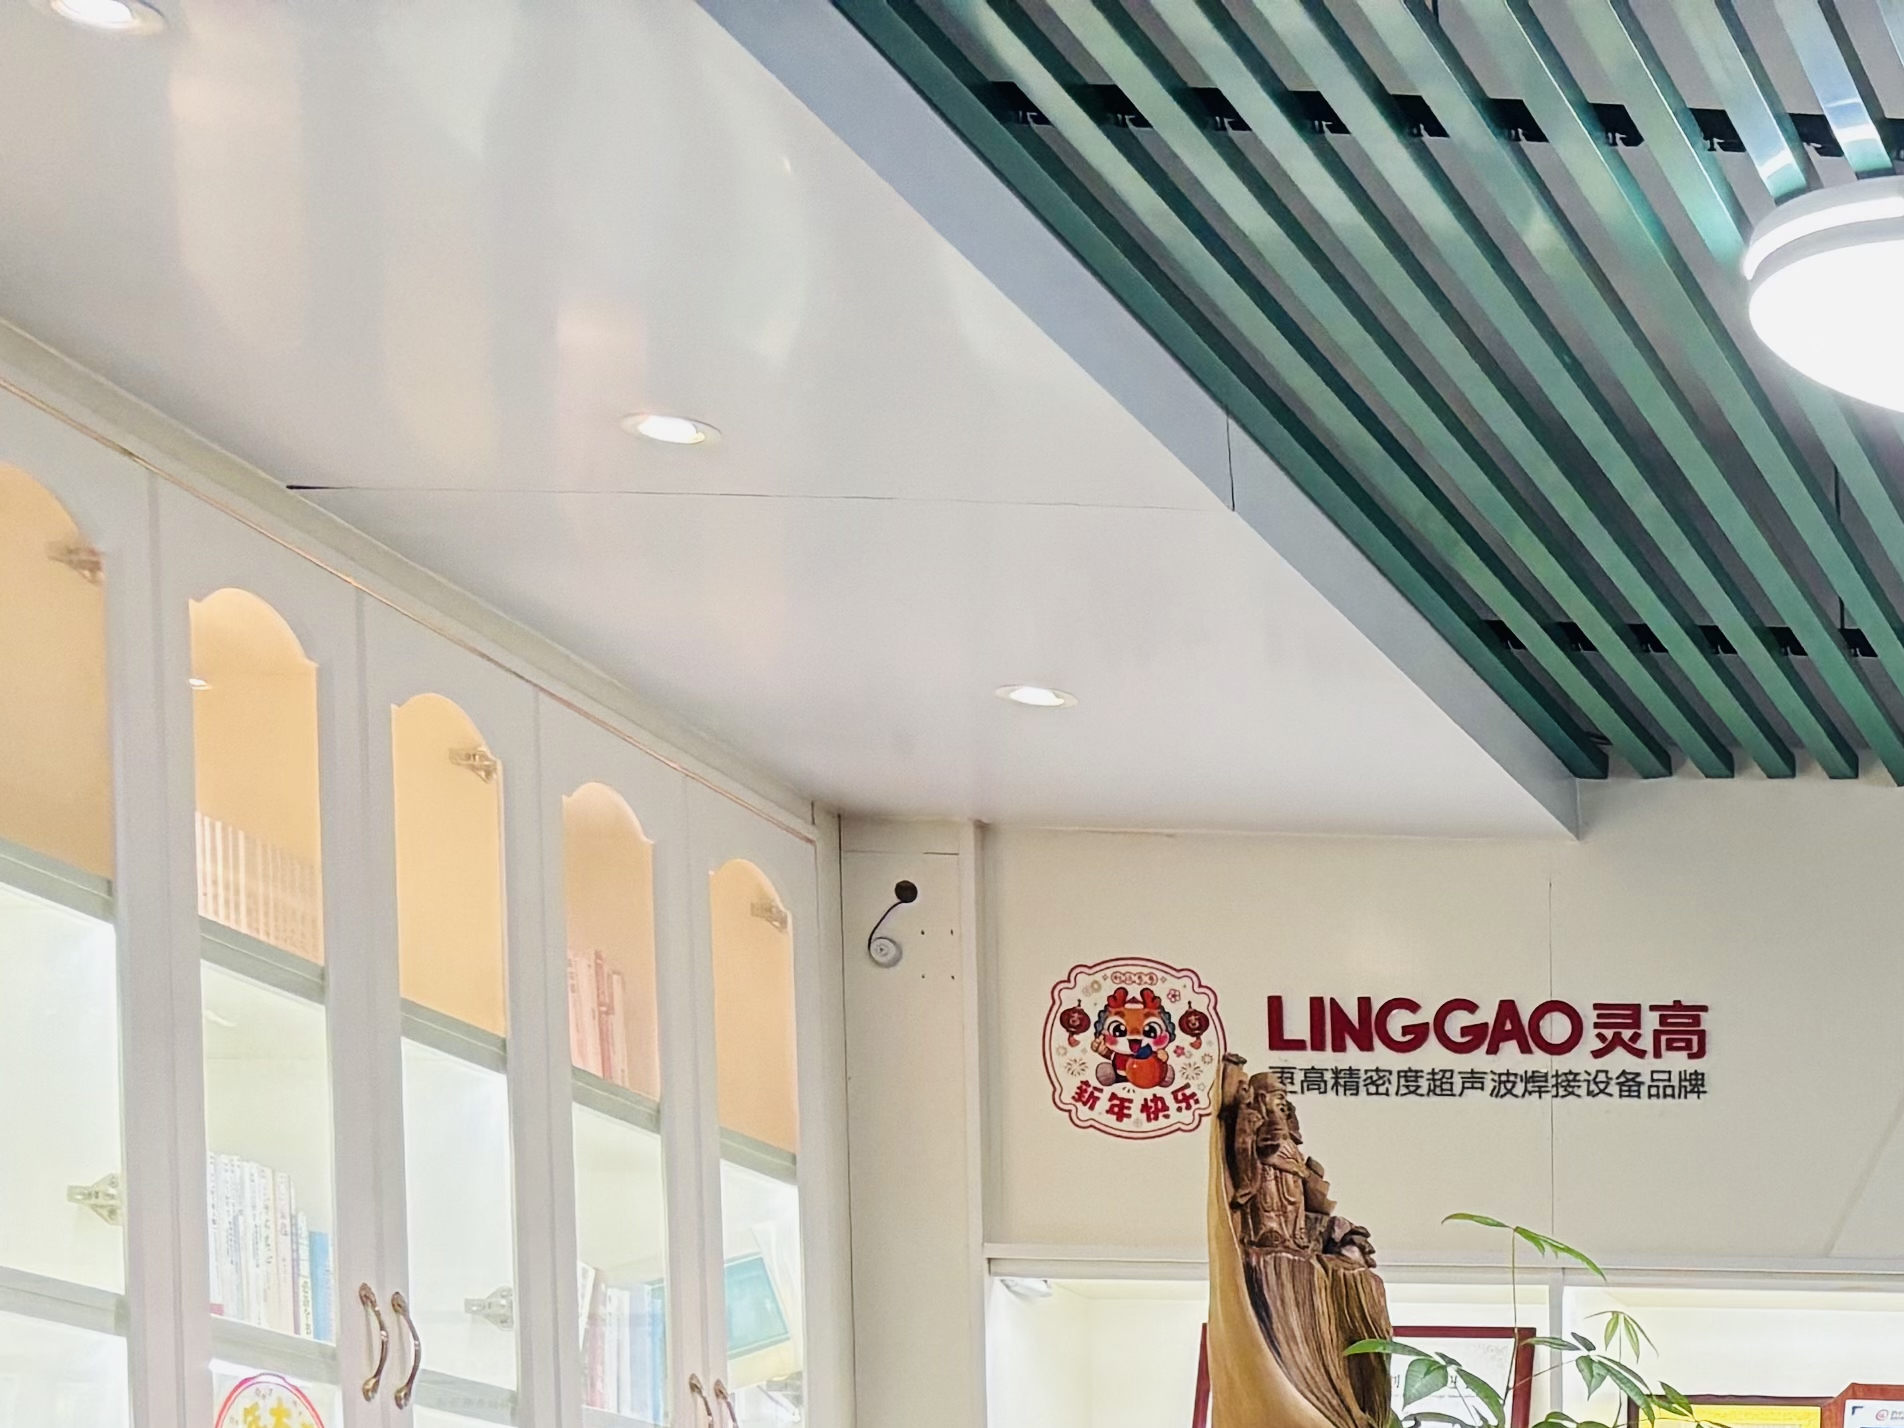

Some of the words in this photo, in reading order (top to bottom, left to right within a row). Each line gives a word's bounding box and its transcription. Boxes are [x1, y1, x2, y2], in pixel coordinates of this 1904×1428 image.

[1266, 995, 1583, 1055] LINGGAO
[1591, 1002, 1709, 1059] 灵高
[1072, 1081, 1203, 1124] 新年快乐
